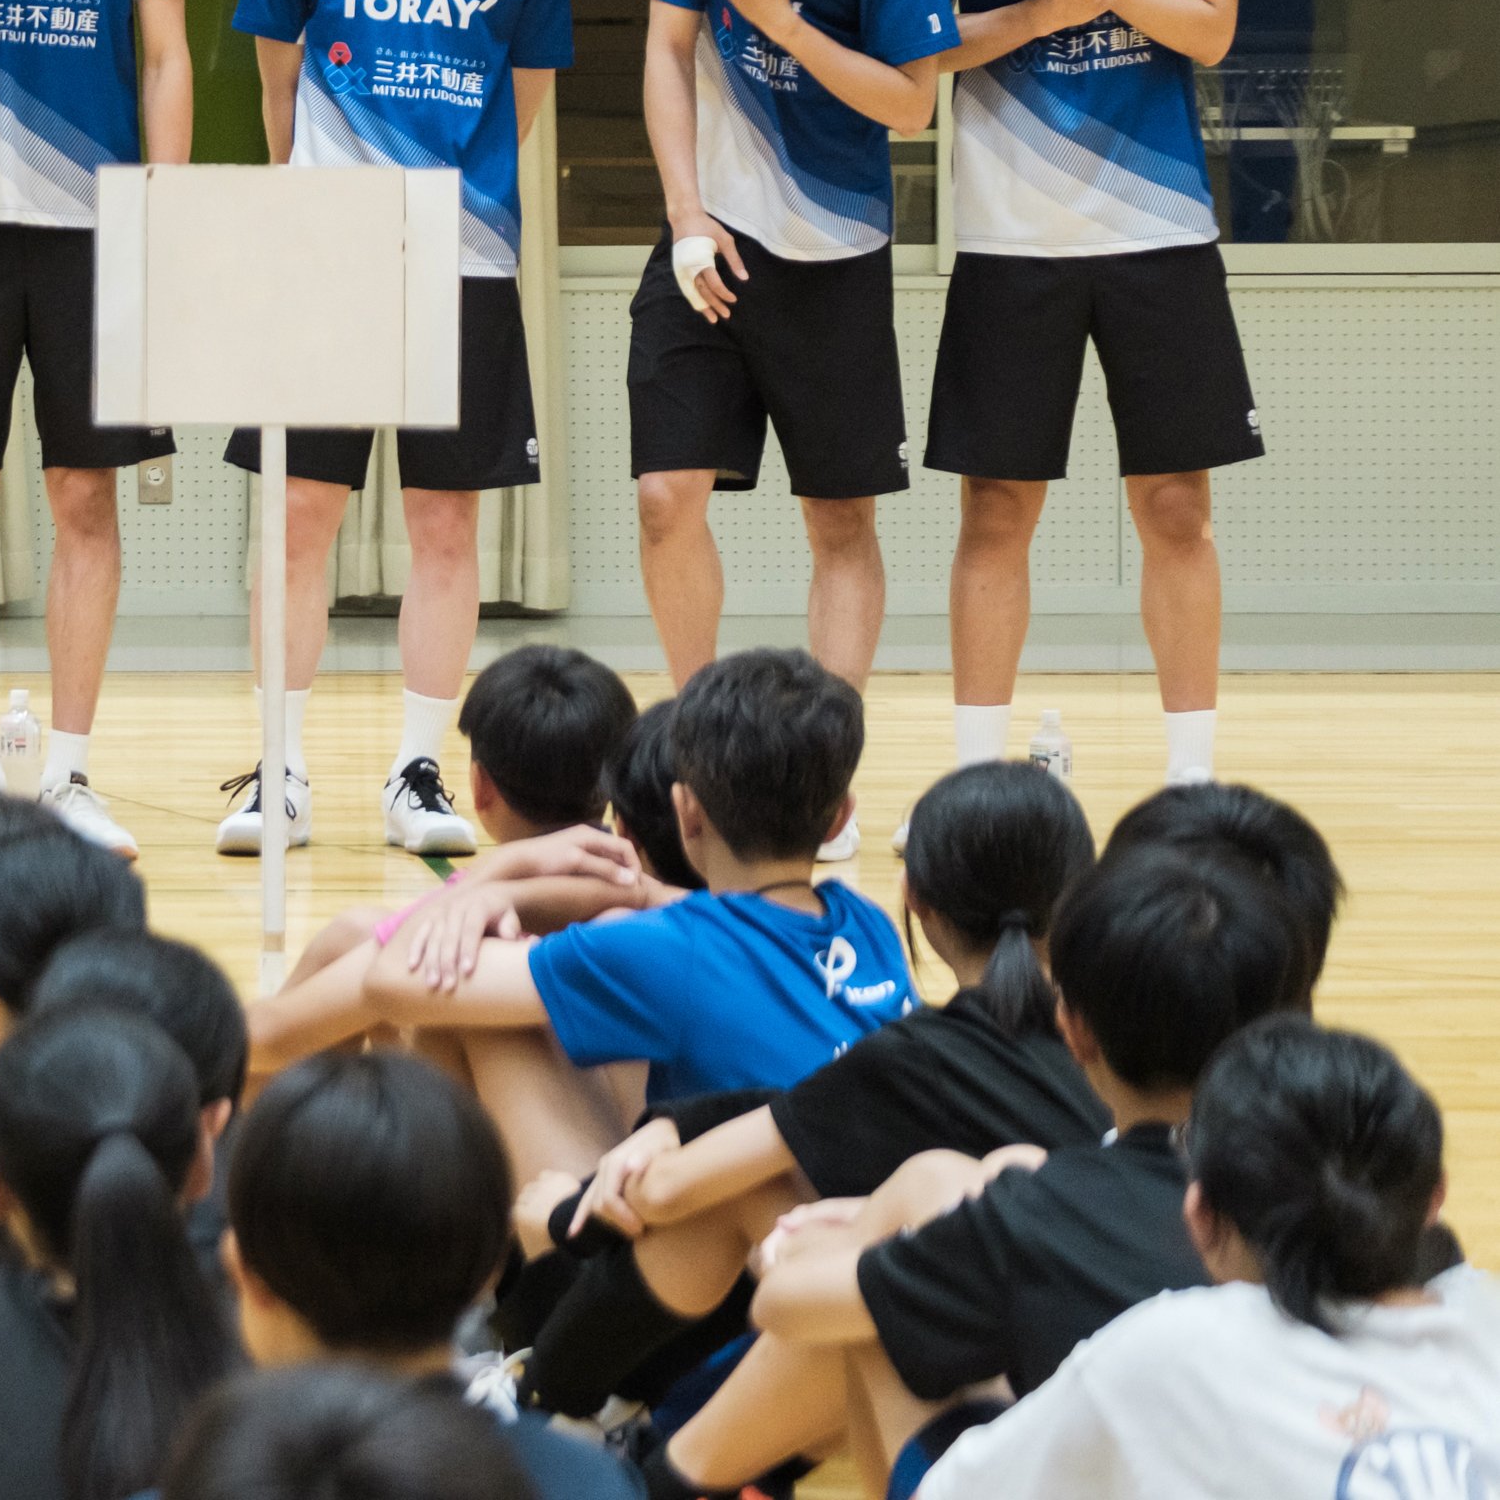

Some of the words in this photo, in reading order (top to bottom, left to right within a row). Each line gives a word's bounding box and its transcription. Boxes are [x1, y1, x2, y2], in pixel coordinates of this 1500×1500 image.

[29, 31, 98, 49] FUDOSAN
[372, 59, 484, 95] 三井不動産
[371, 83, 420, 100] MITSUI
[423, 87, 483, 109] FUDOSAN
